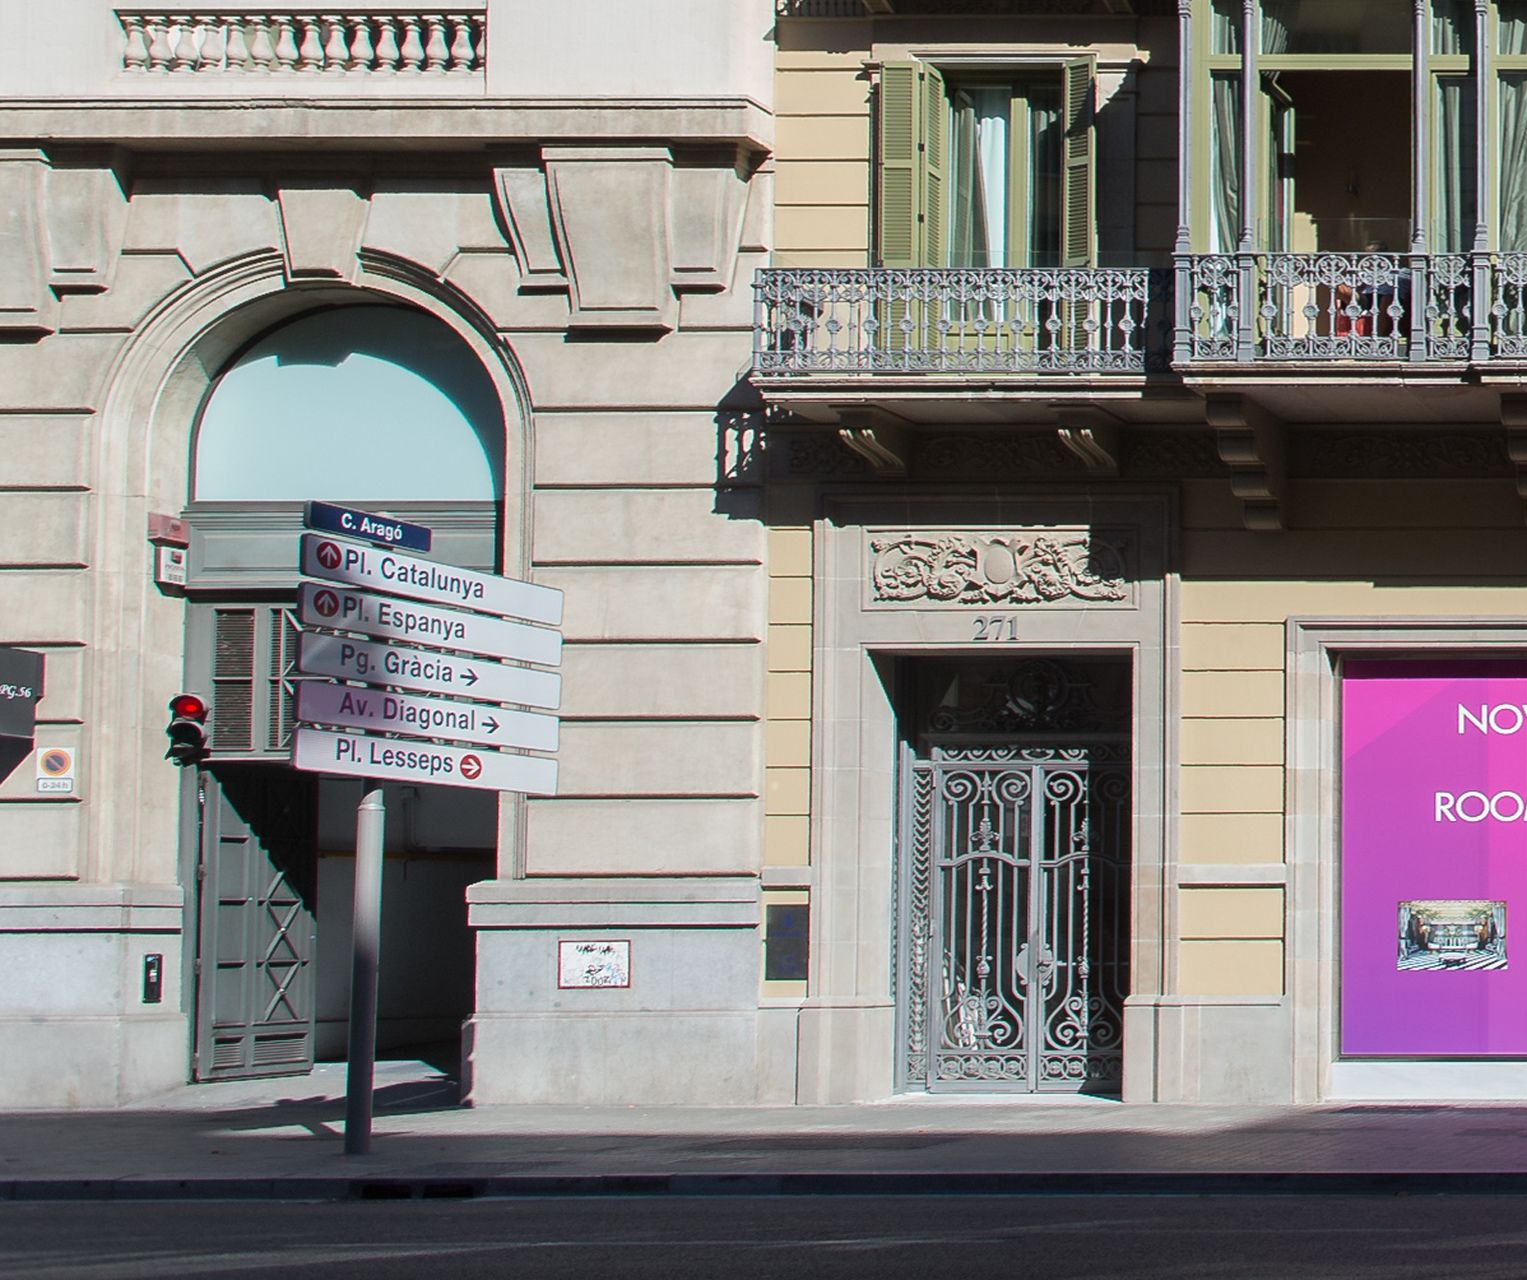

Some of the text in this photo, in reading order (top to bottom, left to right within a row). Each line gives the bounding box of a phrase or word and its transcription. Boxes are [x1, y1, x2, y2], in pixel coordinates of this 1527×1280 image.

[341, 513, 403, 541] C. Aragó
[345, 549, 485, 600] Pl. Catalunya
[343, 595, 466, 639] Pl. Espanya
[973, 615, 1020, 640] 271
[340, 644, 453, 683] Pg. Gràcia
[339, 692, 476, 730] Av. Diagonal
[335, 738, 454, 776] Pl. Lesseps
